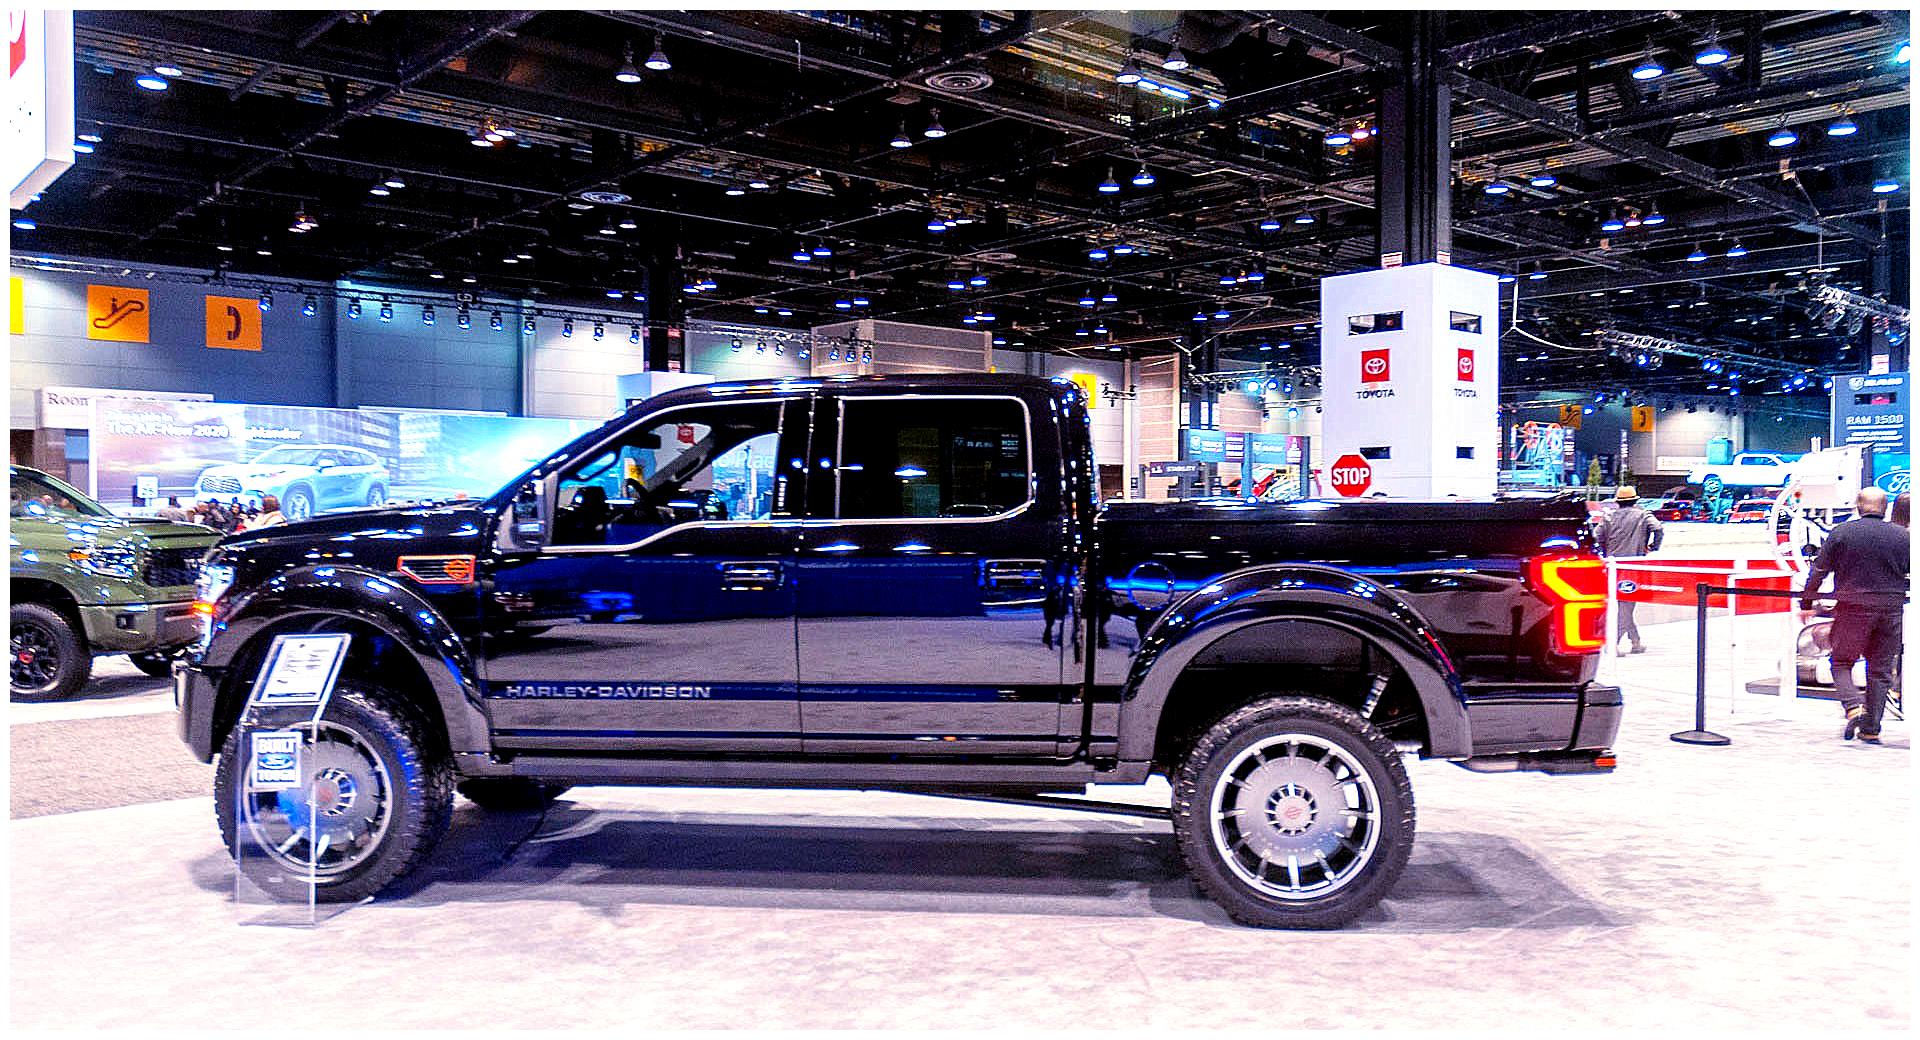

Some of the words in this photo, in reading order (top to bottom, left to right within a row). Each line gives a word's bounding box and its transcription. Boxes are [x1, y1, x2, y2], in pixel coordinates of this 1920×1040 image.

[1356, 389, 1395, 399] TOYOTA
[1454, 388, 1478, 398] TOYOTA
[1332, 467, 1370, 486] STOP
[505, 685, 711, 698] HARLEY-DAVIDSON
